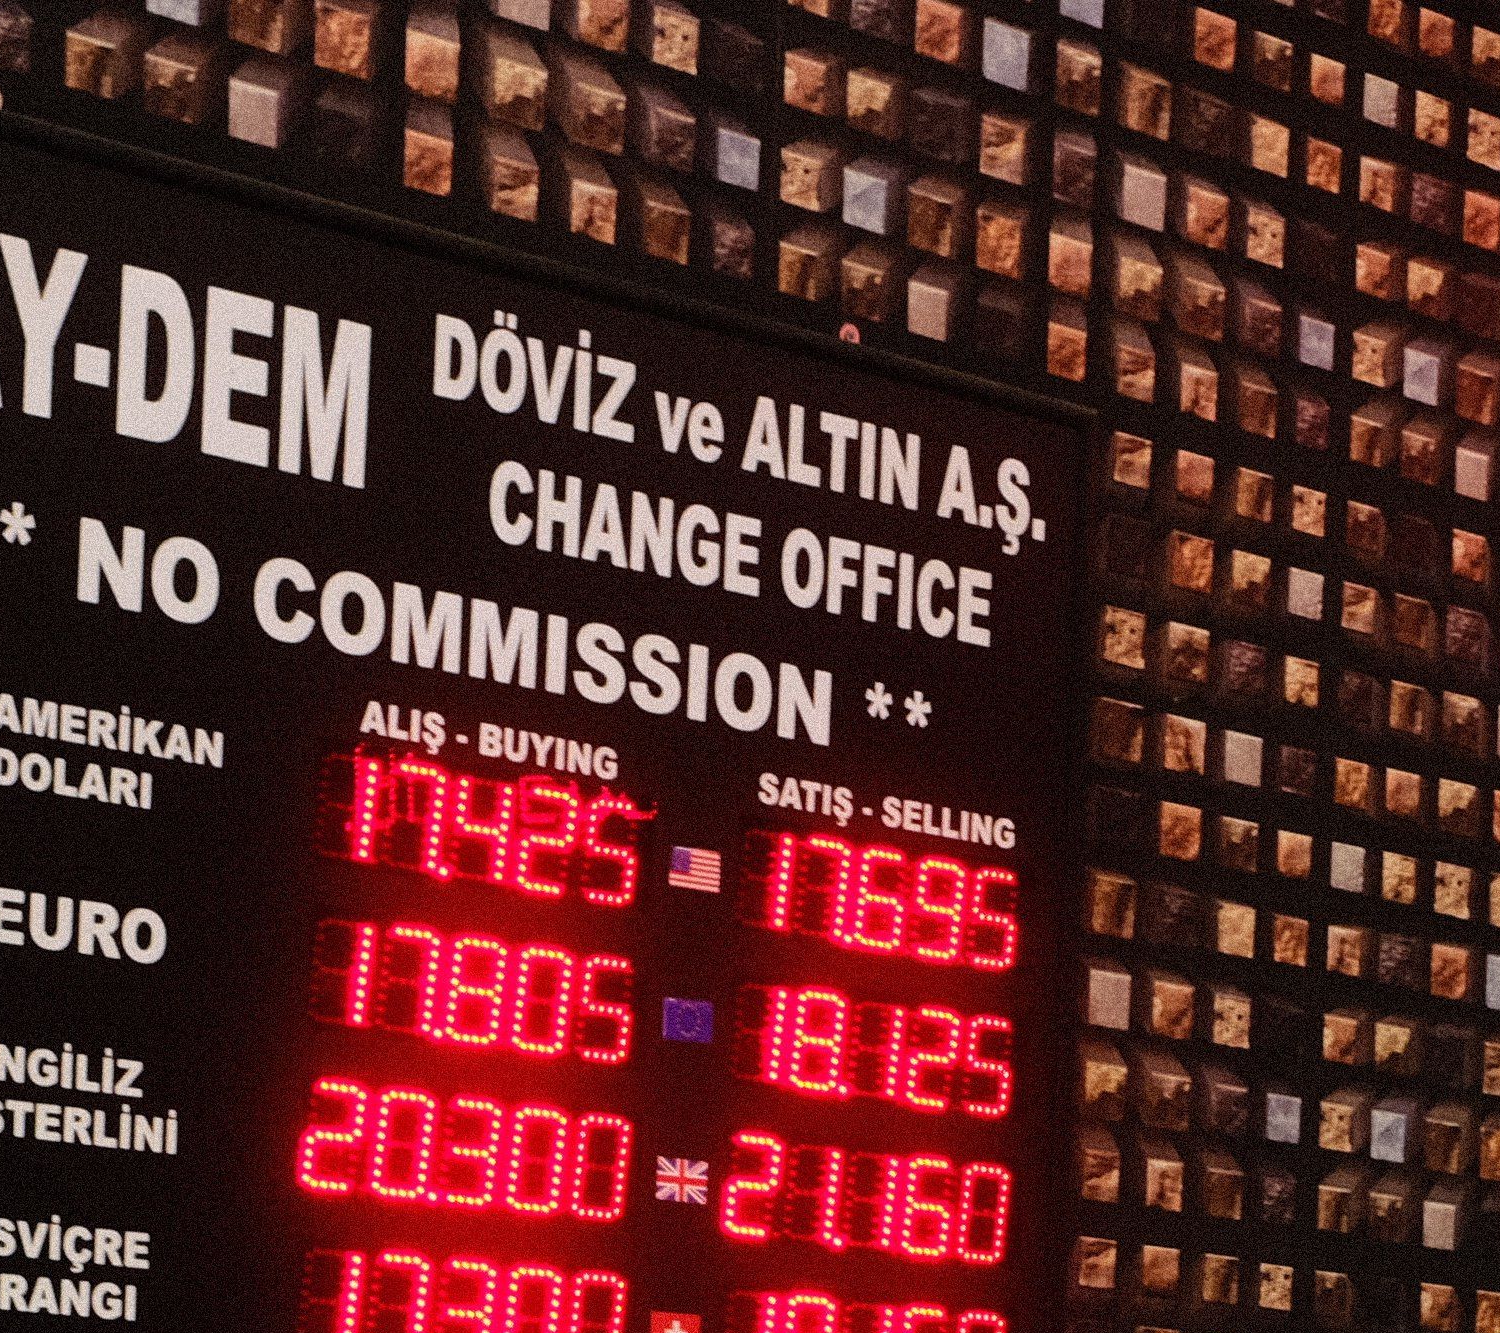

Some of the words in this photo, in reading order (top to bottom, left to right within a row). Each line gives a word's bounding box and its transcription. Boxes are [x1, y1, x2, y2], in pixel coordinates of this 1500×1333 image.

[433, 309, 636, 443] DÖVİZ
[654, 390, 724, 463] ve
[741, 395, 920, 510] ALTIN
[937, 444, 1046, 555] A.Ş.
[489, 460, 762, 597] CHANGE
[781, 528, 991, 647] OFFICE
[77, 517, 220, 625] NO
[253, 557, 832, 746] COMMISSION
[360, 700, 446, 754] ALIŞ
[478, 722, 618, 781] BUYING
[357, 755, 637, 907] 17.425
[758, 772, 852, 827] SATIŞ
[881, 795, 1016, 850] SELLING
[771, 832, 1018, 972] 17.695
[351, 924, 635, 1064] 17.805
[767, 989, 1012, 1119] 18.125
[298, 1077, 633, 1221] 20.300
[721, 1130, 1011, 1264] 21.160
